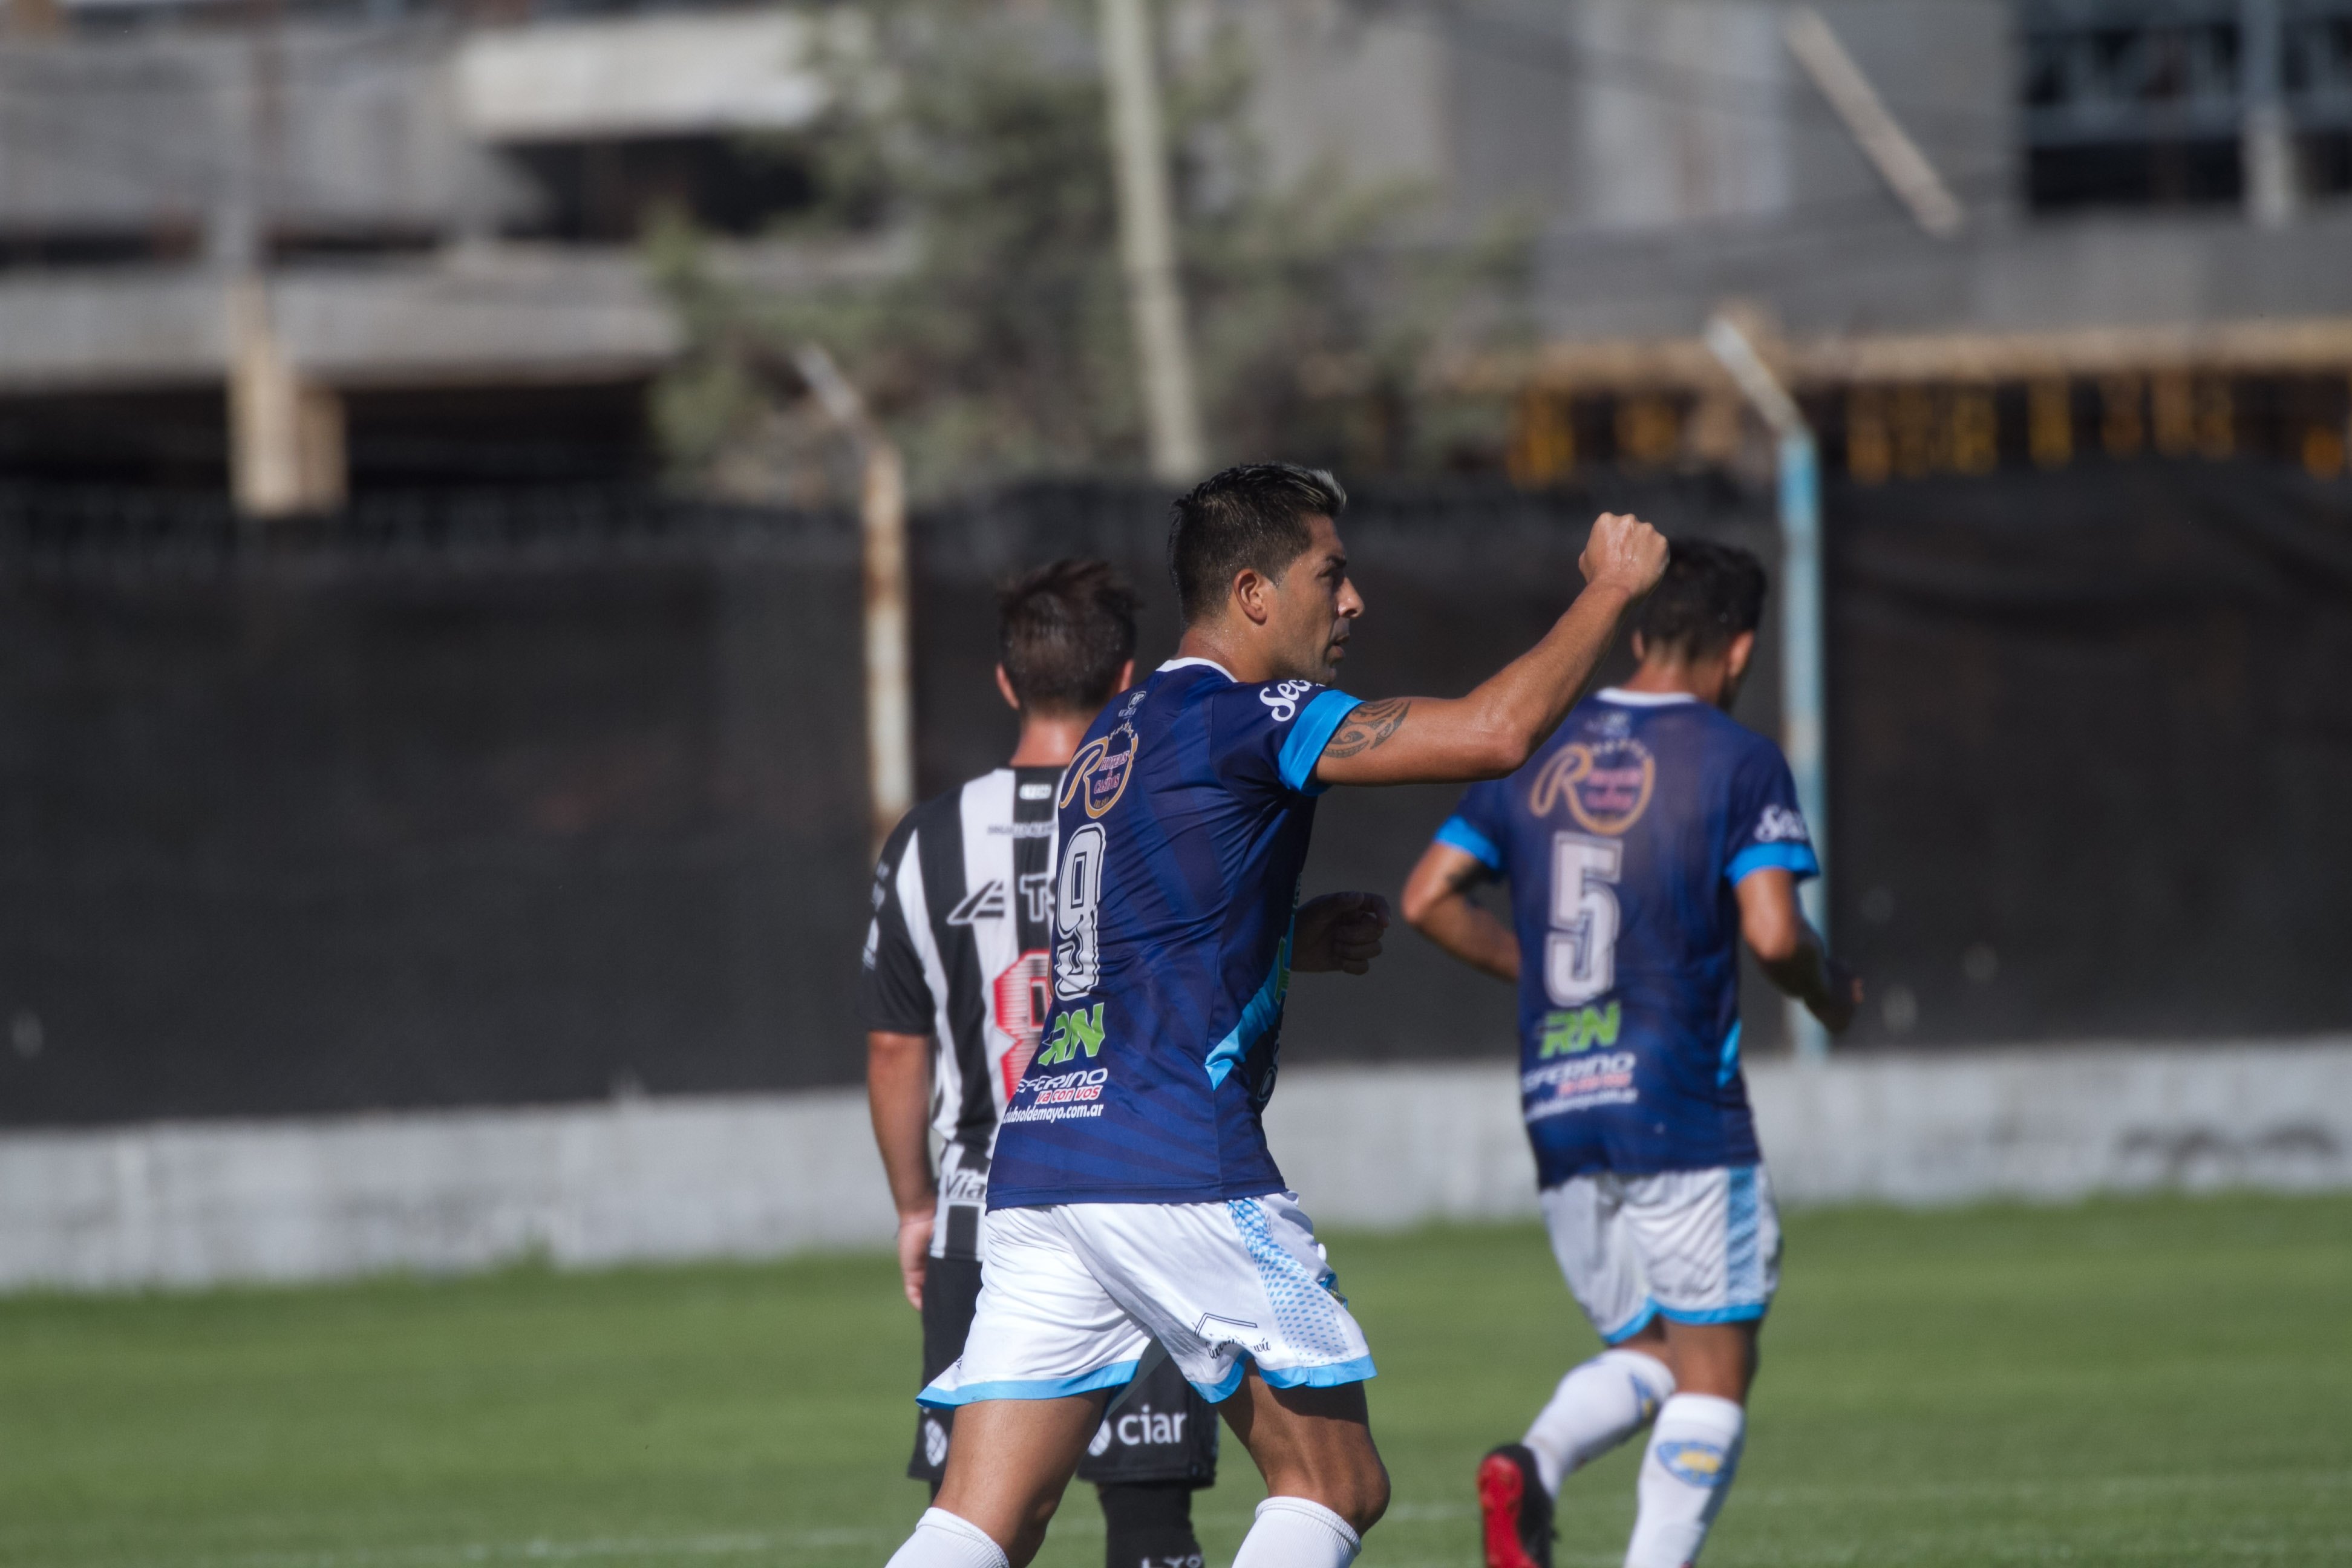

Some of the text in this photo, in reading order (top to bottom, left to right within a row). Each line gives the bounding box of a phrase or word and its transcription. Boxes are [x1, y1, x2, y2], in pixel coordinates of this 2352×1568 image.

[1259, 679, 1326, 722] Sec
[1054, 822, 1106, 1001] 9
[1543, 831, 1623, 1008] 5
[1034, 1085, 1103, 1105] va con vos
[1117, 1404, 1187, 1445] ciar
